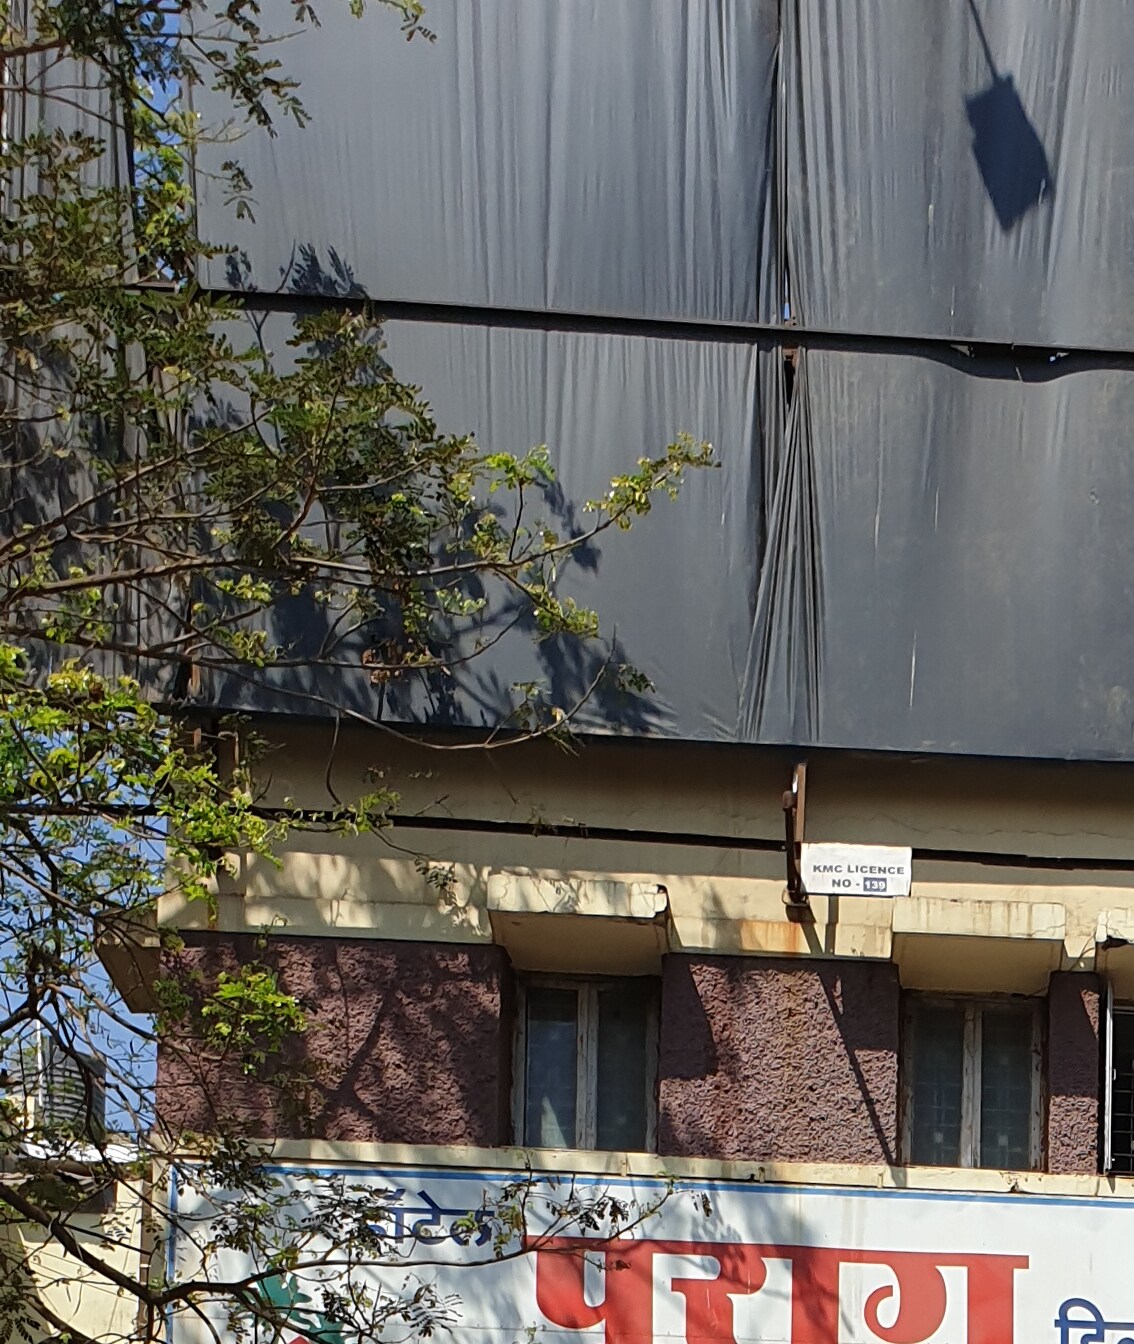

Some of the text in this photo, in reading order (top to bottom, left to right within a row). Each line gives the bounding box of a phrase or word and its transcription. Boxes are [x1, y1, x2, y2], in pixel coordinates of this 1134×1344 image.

[812, 864, 904, 875] KMC LICENCE
[832, 879, 852, 888] NO
[864, 880, 886, 890] 139
